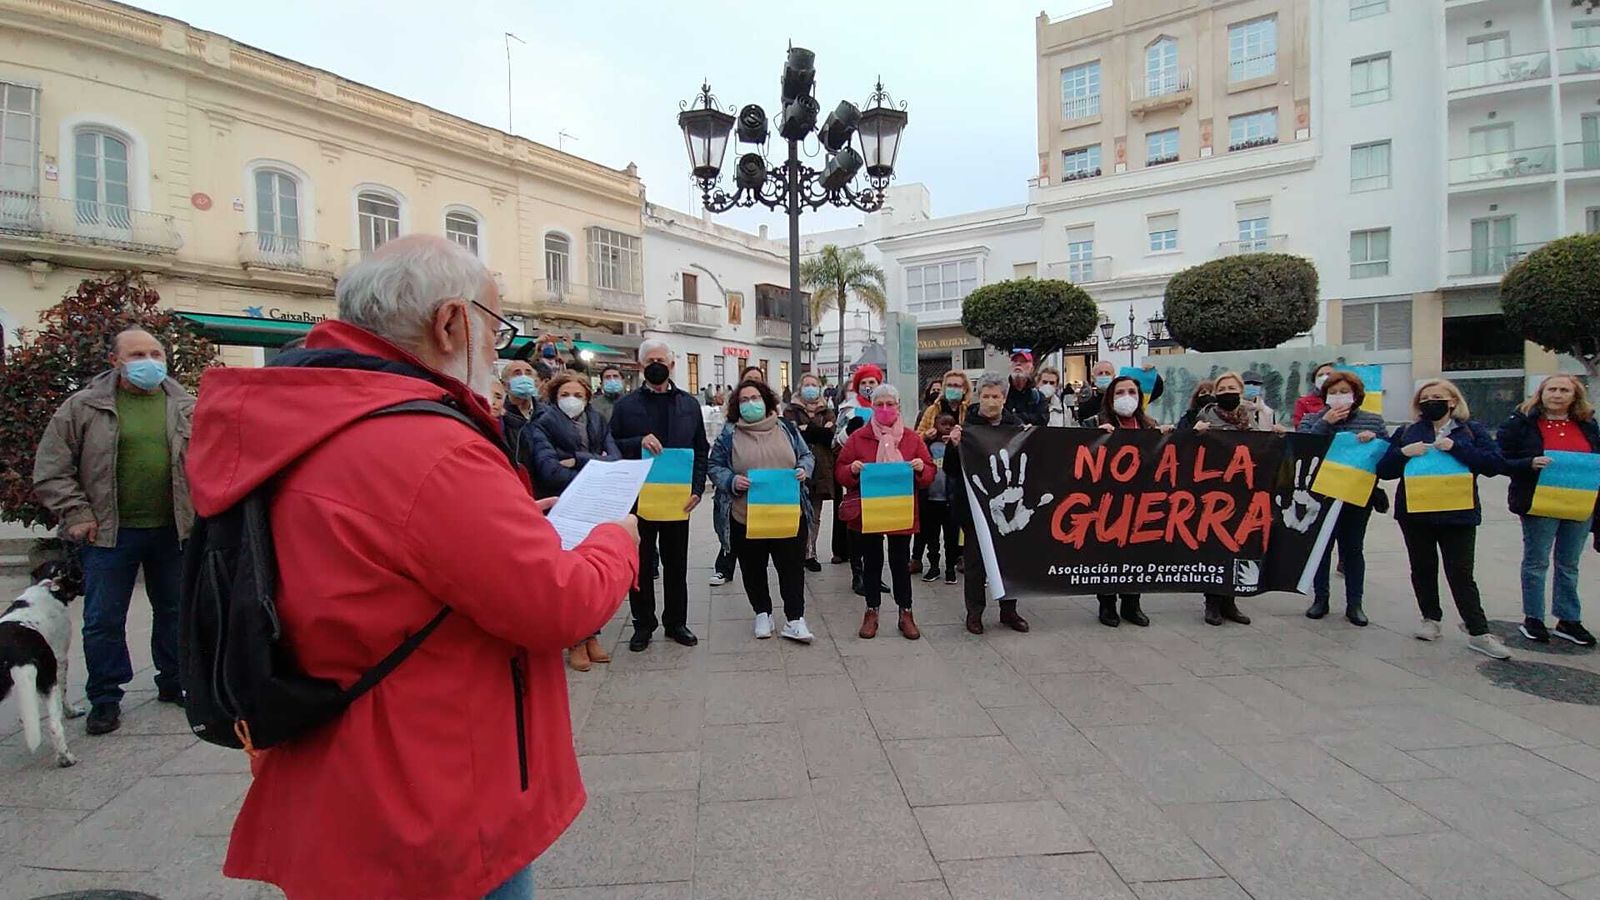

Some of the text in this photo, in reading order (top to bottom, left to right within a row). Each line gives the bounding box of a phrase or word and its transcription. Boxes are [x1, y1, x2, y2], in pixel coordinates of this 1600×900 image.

[269, 308, 328, 323] CaixaBank
[1074, 444, 1256, 489] NO A LA
[1051, 490, 1273, 554] GUERRA
[1048, 563, 1118, 575] Asociación
[1122, 563, 1144, 573] Pro
[1147, 562, 1225, 574] Dererechos
[1070, 572, 1223, 585] Humanos de Andalucía
